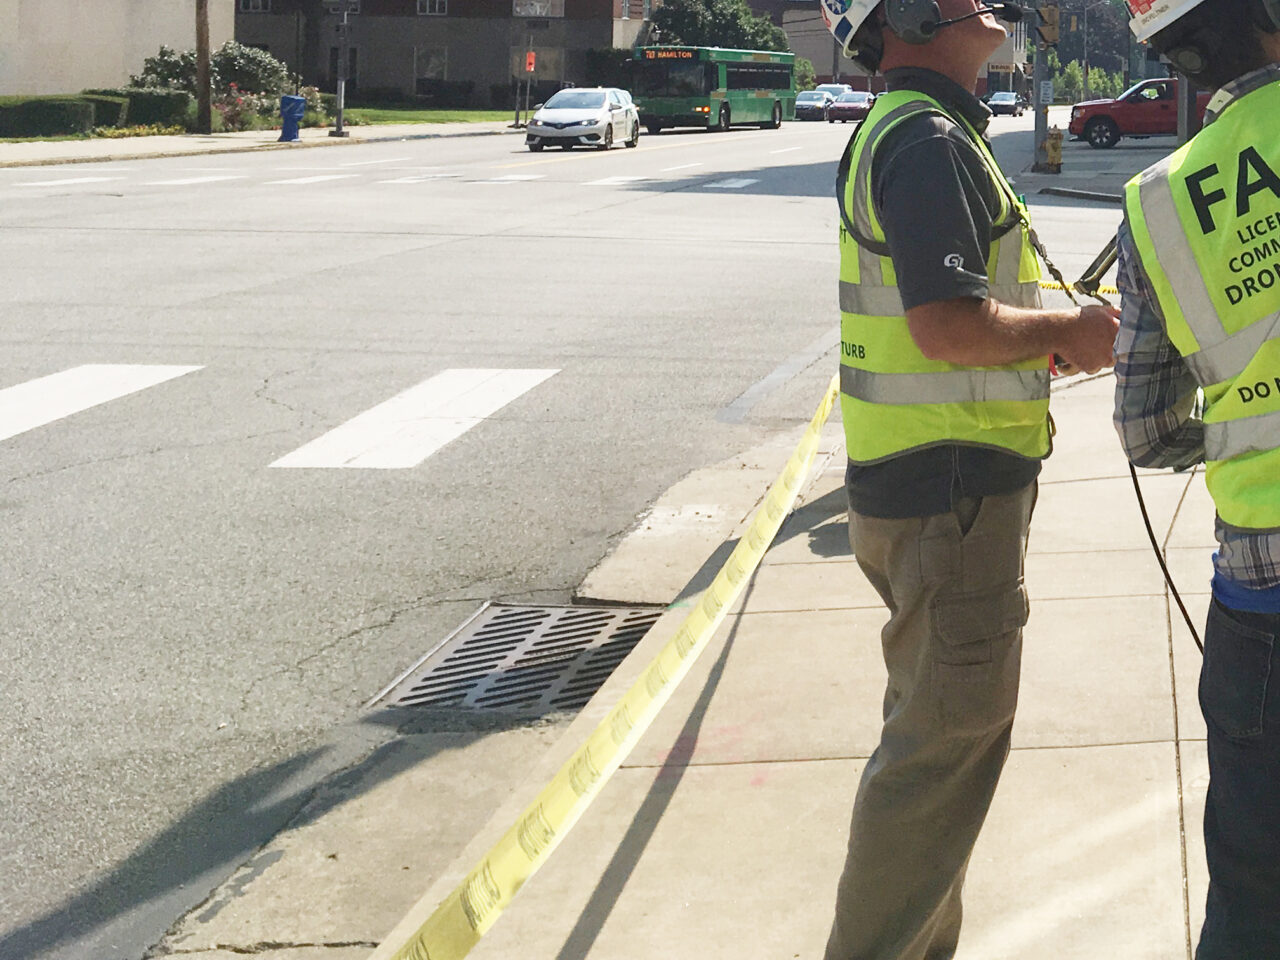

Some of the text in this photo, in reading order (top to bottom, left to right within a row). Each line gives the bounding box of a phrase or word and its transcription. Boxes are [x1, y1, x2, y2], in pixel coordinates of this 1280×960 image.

[658, 50, 692, 59] HAMILTON
[841, 340, 866, 359] TURB
[1237, 381, 1271, 403] DO
